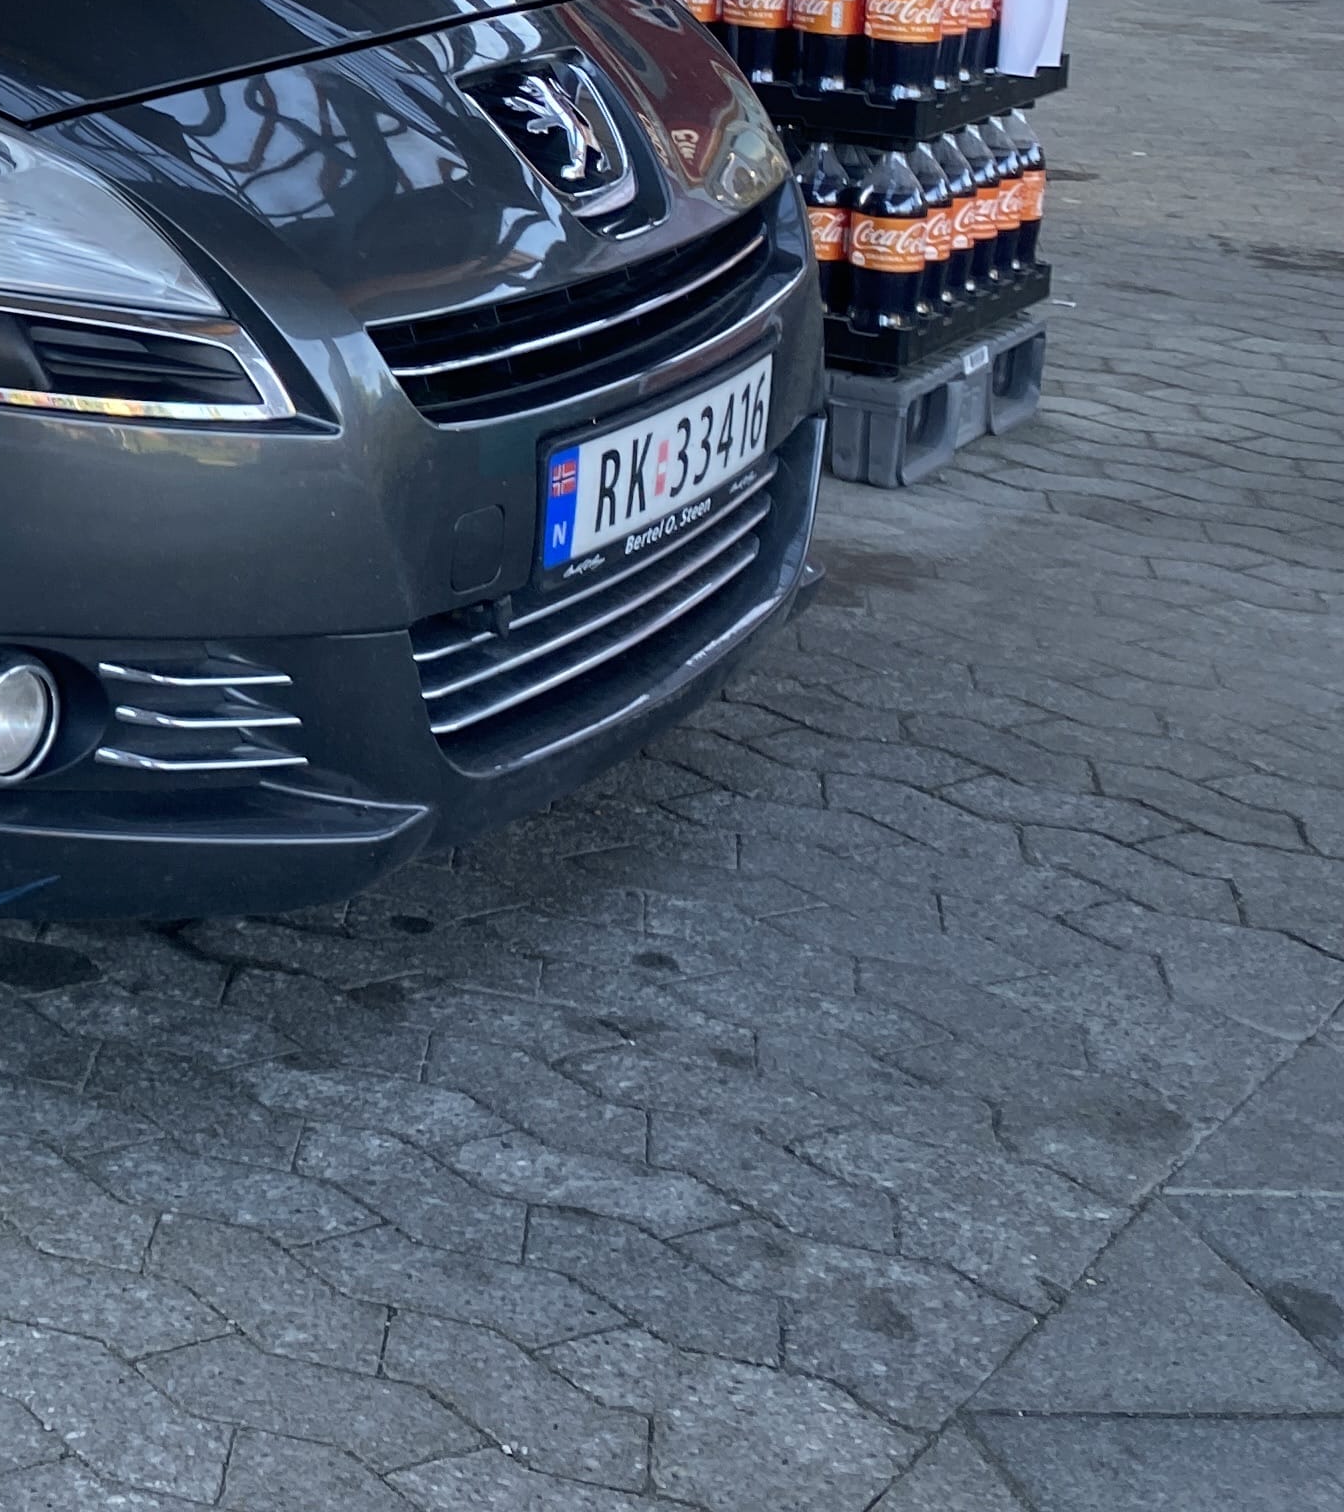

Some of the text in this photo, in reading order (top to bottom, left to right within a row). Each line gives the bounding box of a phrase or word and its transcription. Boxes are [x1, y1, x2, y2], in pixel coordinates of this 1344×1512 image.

[594, 371, 766, 534] RK 33416
[552, 521, 567, 548] N
[624, 497, 712, 556] Bertel O. Steen
